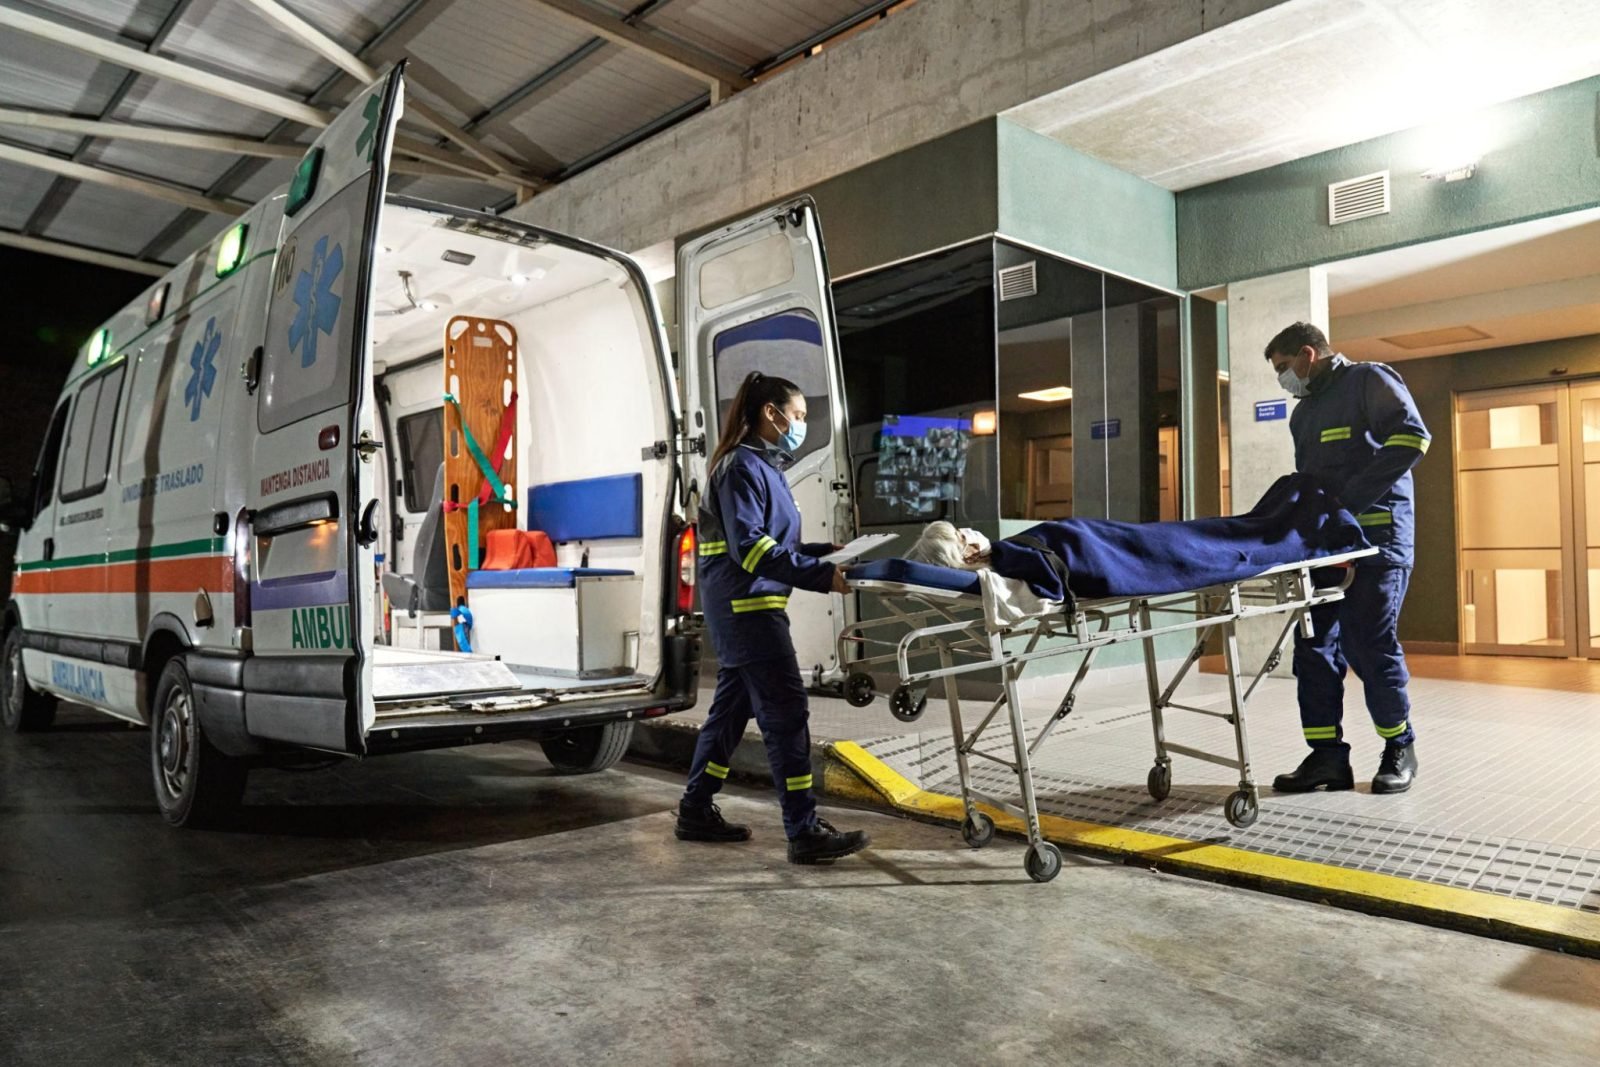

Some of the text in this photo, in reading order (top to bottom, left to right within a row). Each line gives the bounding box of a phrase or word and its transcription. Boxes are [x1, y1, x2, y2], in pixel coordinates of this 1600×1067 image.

[159, 463, 204, 493] TRASLADO
[260, 457, 331, 497] MANTENGA DISTANCIA
[51, 659, 108, 703] AMBULANCIA
